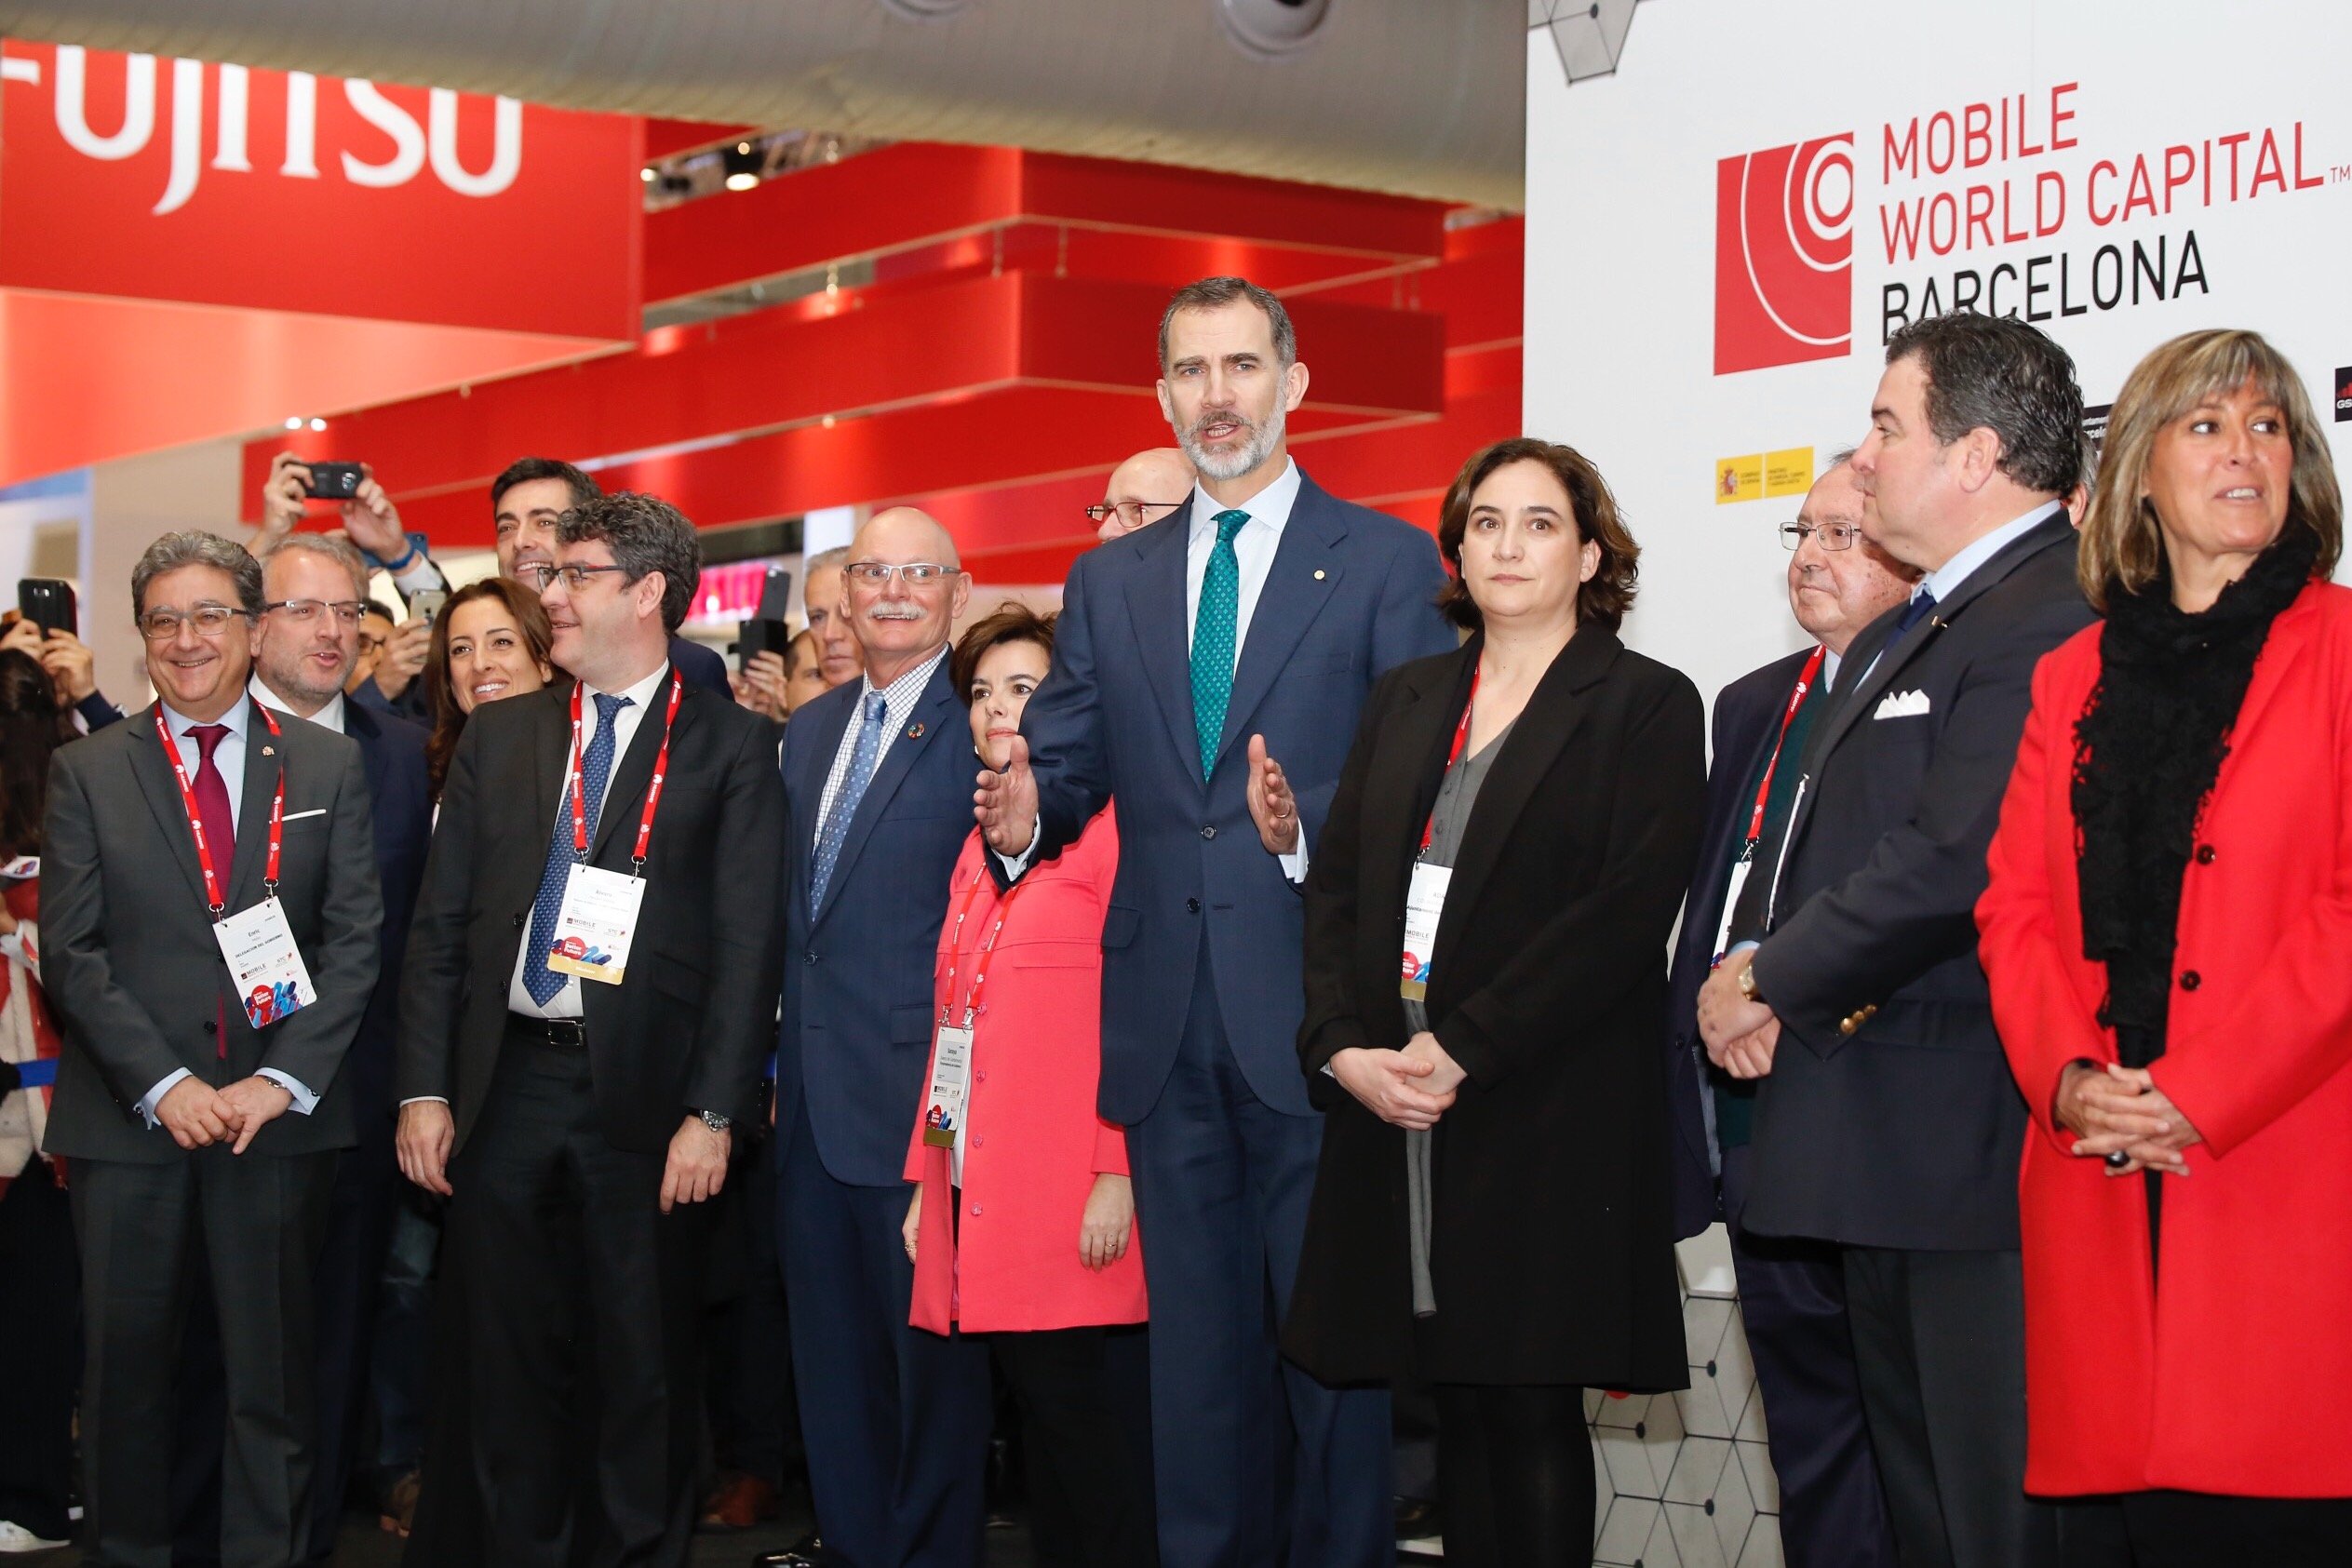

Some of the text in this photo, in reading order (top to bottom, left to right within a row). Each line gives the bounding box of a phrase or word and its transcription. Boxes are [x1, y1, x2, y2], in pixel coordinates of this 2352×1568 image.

[0, 45, 523, 216] UJITSU
[1878, 170, 2066, 265] WORLD
[2086, 121, 2325, 226] CAPITAL
[1882, 81, 2079, 185] MOBILE
[1881, 229, 2210, 347] BARCELONA
